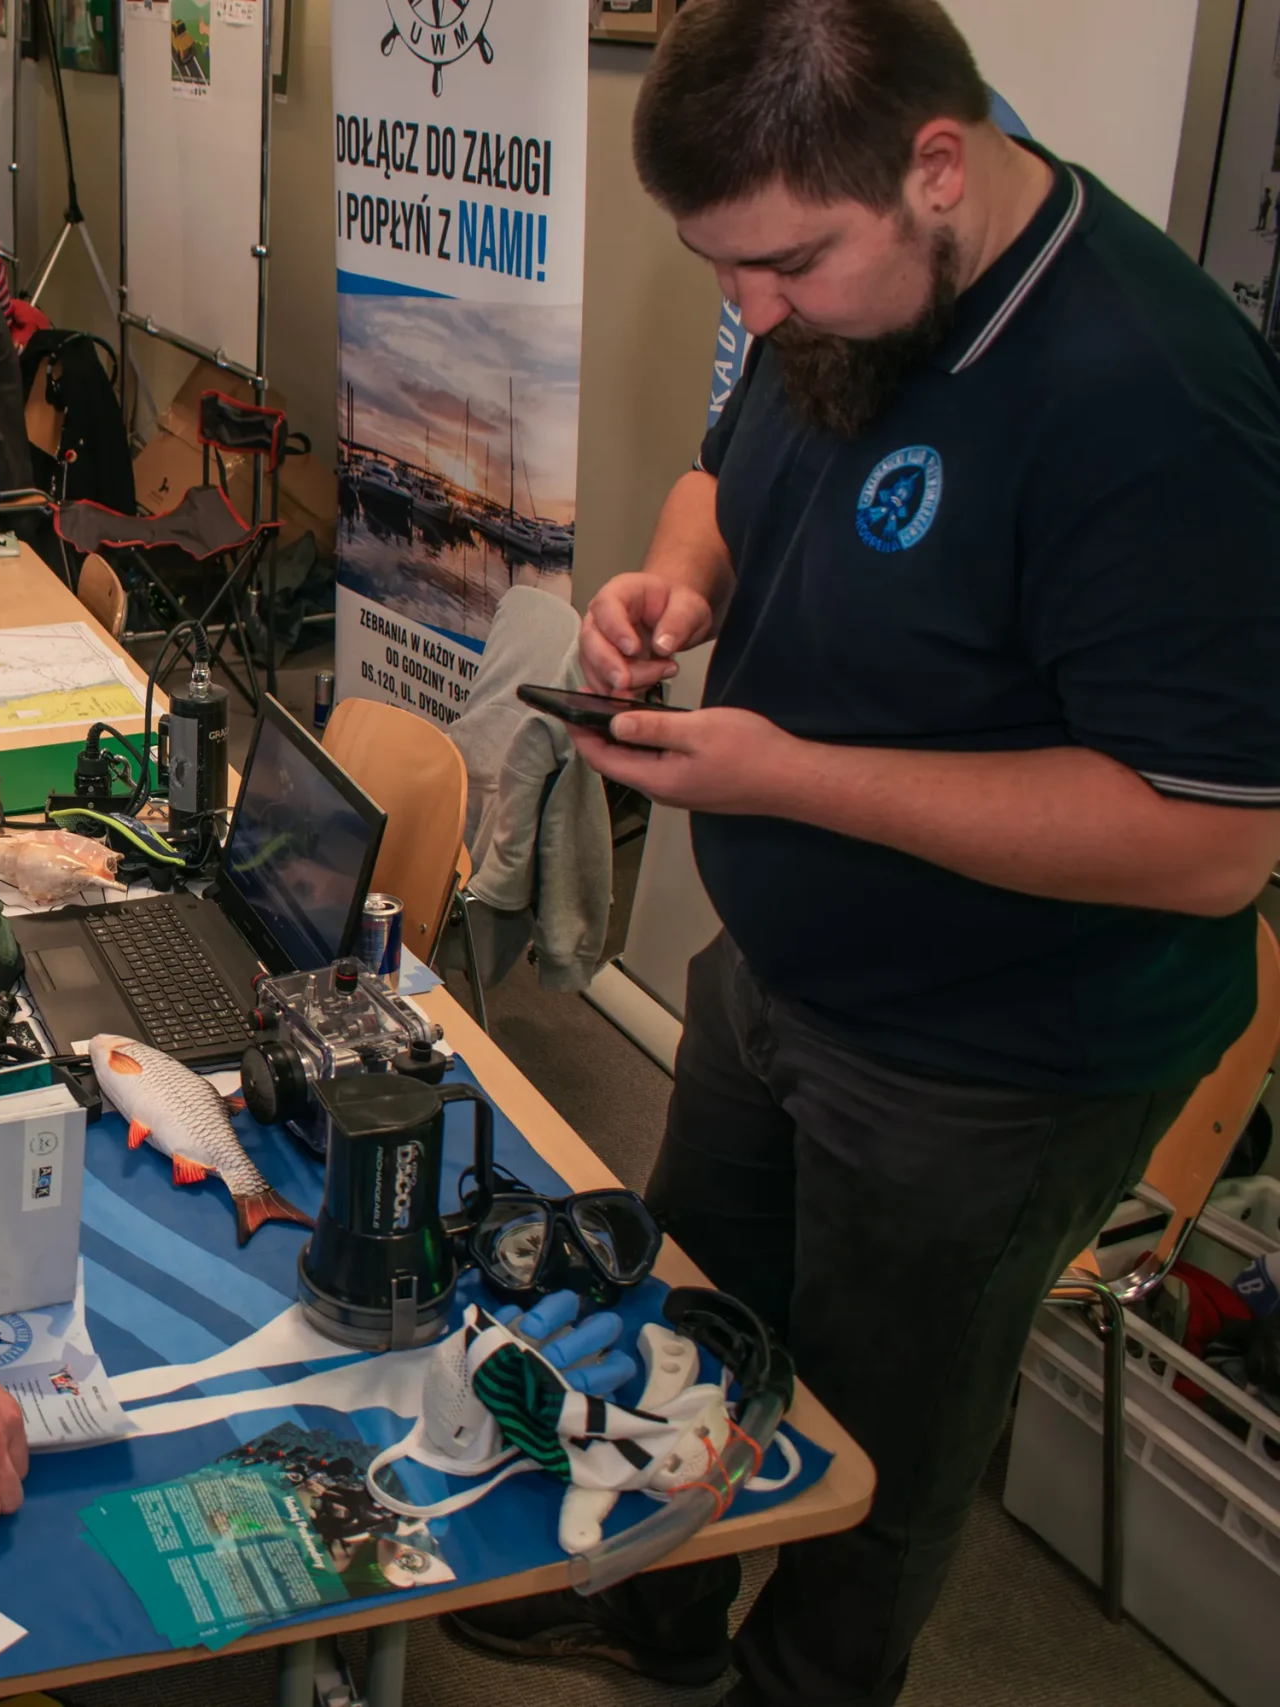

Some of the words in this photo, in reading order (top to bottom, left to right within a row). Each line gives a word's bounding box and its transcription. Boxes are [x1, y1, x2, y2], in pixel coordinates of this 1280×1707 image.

[410, 21, 469, 56] UWM
[336, 113, 419, 180] DOŁĄCZ
[426, 124, 456, 180] DO
[462, 129, 552, 196] ZAŁOGI
[337, 190, 342, 238] I
[346, 193, 431, 256] POPŁYŃ
[458, 200, 547, 283] NAMI!
[360, 608, 408, 648] ZEBRANIA
[410, 632, 421, 653] W
[423, 638, 455, 672] KAŻDY
[361, 660, 398, 699] DS.120,
[401, 681, 416, 706] UL.
[386, 647, 399, 668] OD
[402, 655, 445, 694] GODZINY
